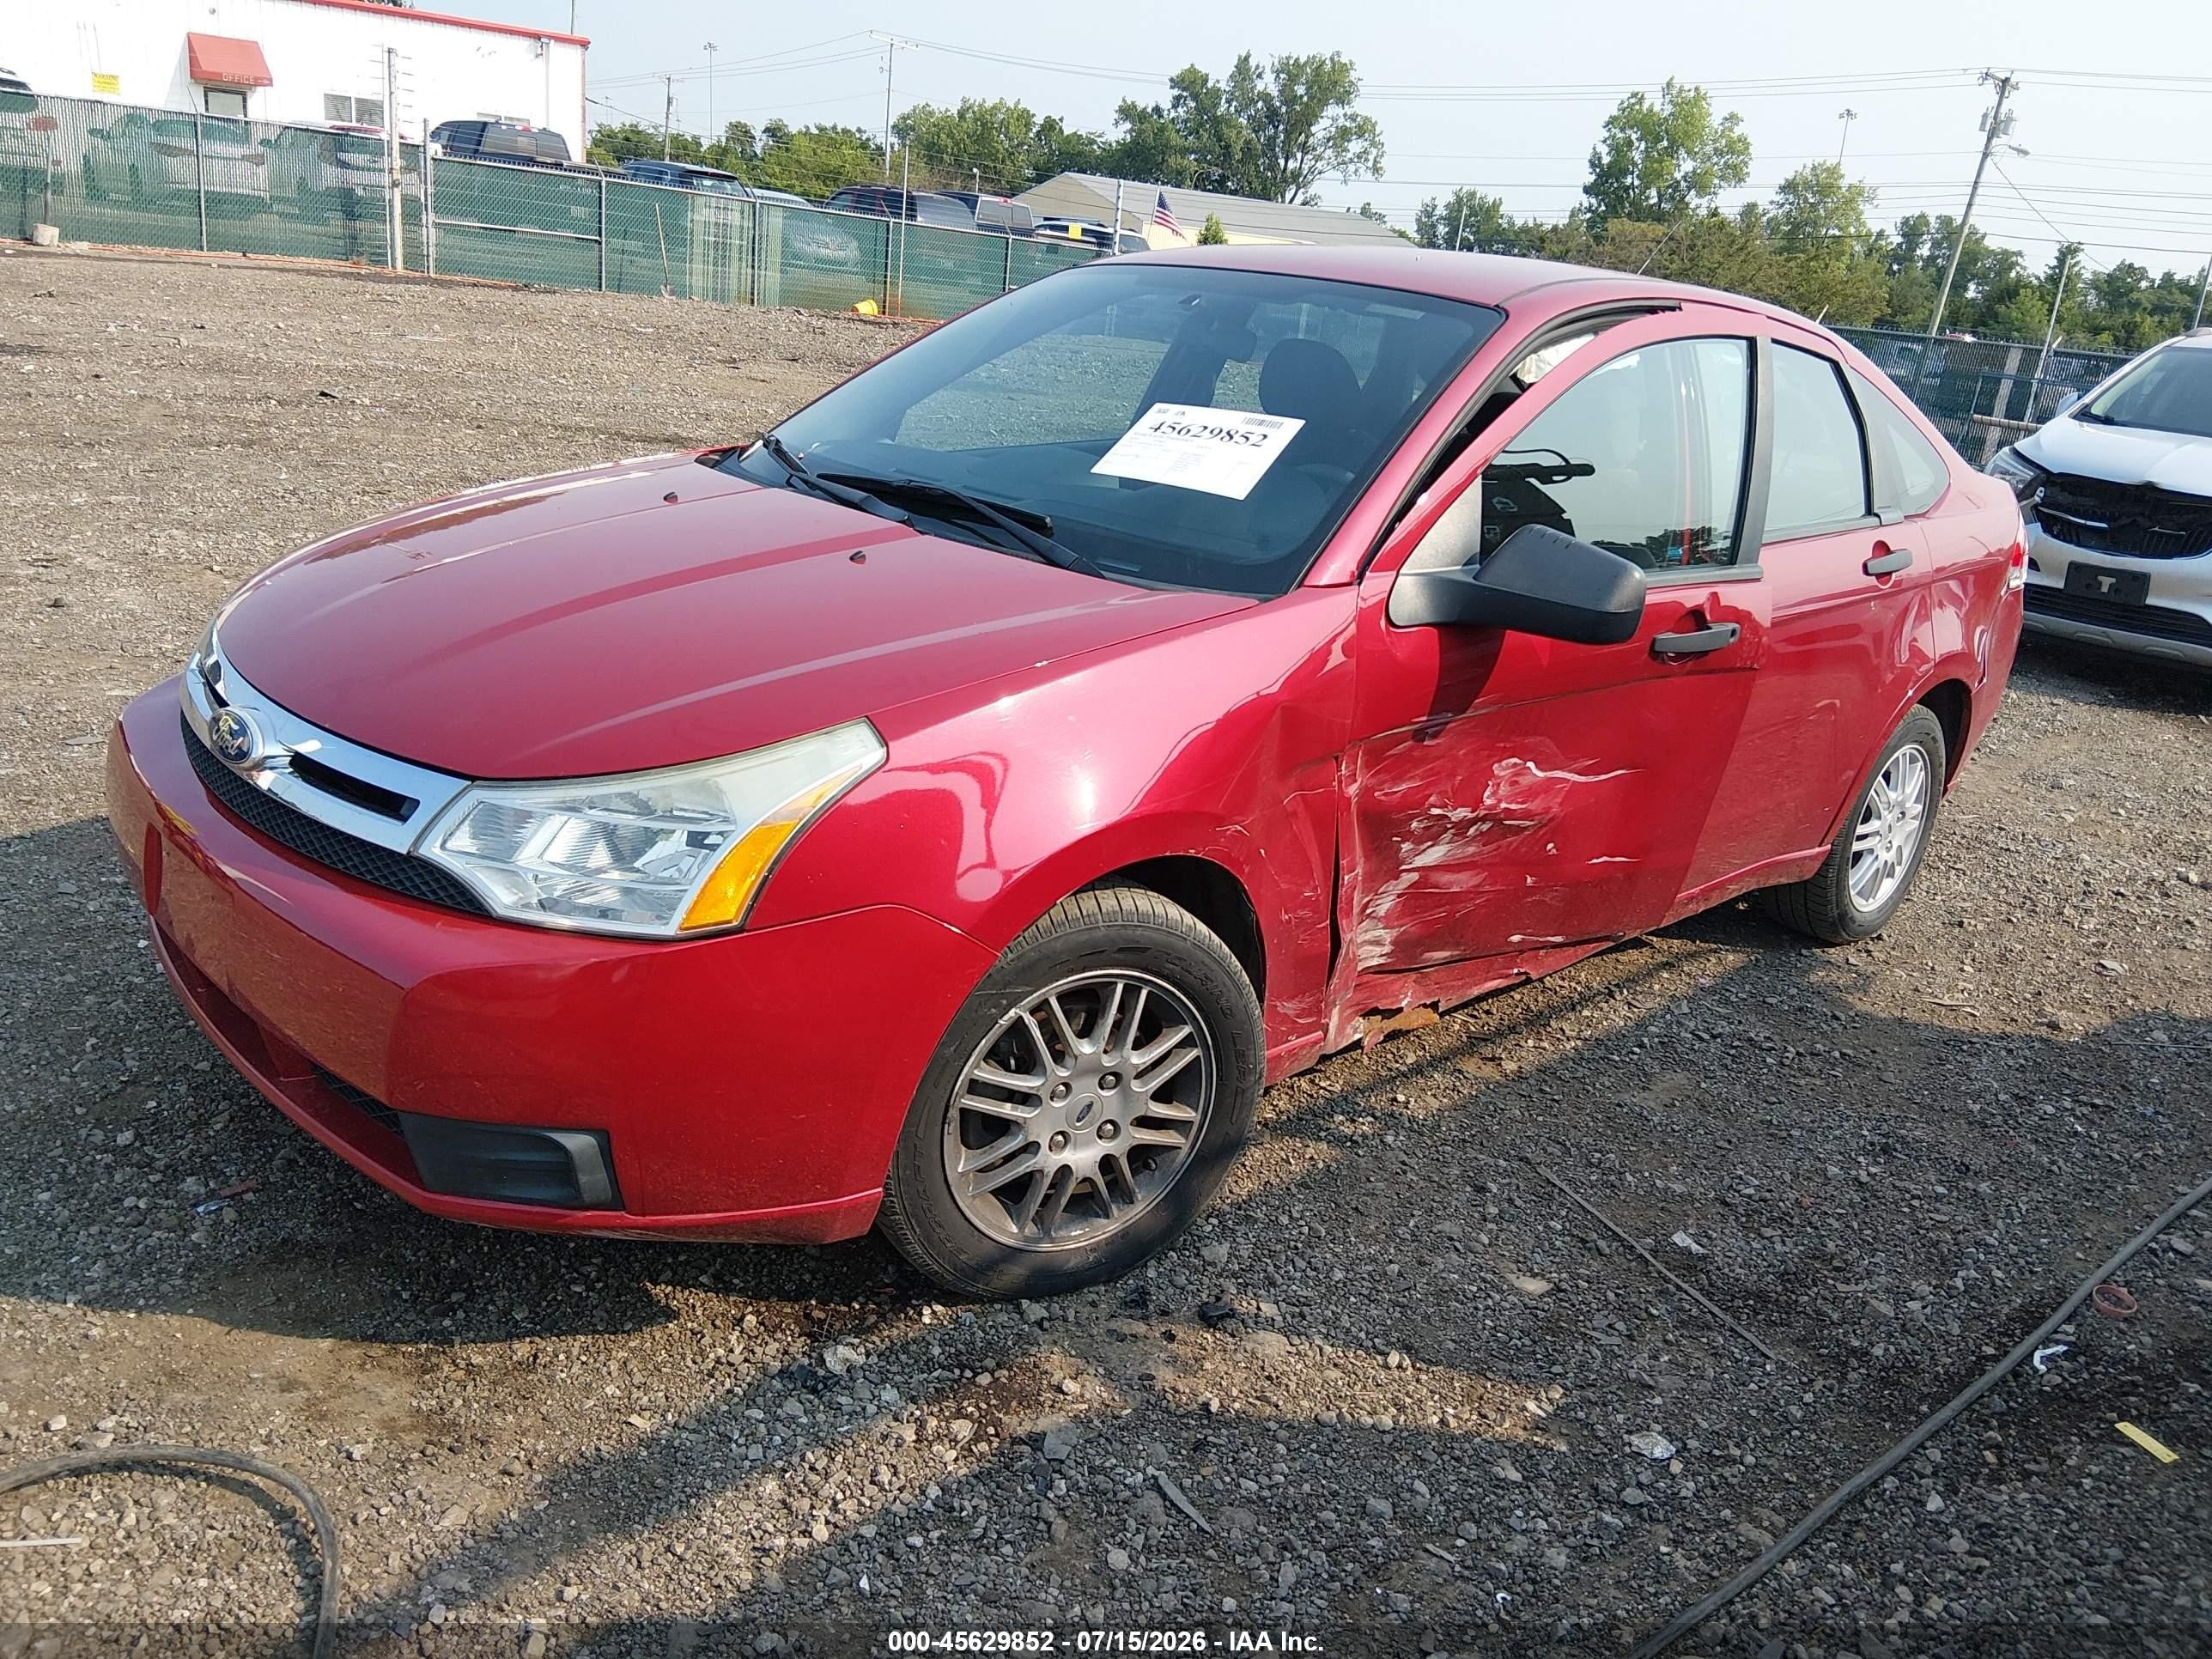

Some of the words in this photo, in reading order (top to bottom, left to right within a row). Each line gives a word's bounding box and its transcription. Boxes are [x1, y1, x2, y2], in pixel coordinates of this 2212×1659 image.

[222, 73, 255, 84] OFFICE
[1148, 420, 1269, 447] 45629852
[212, 714, 245, 757] Ford
